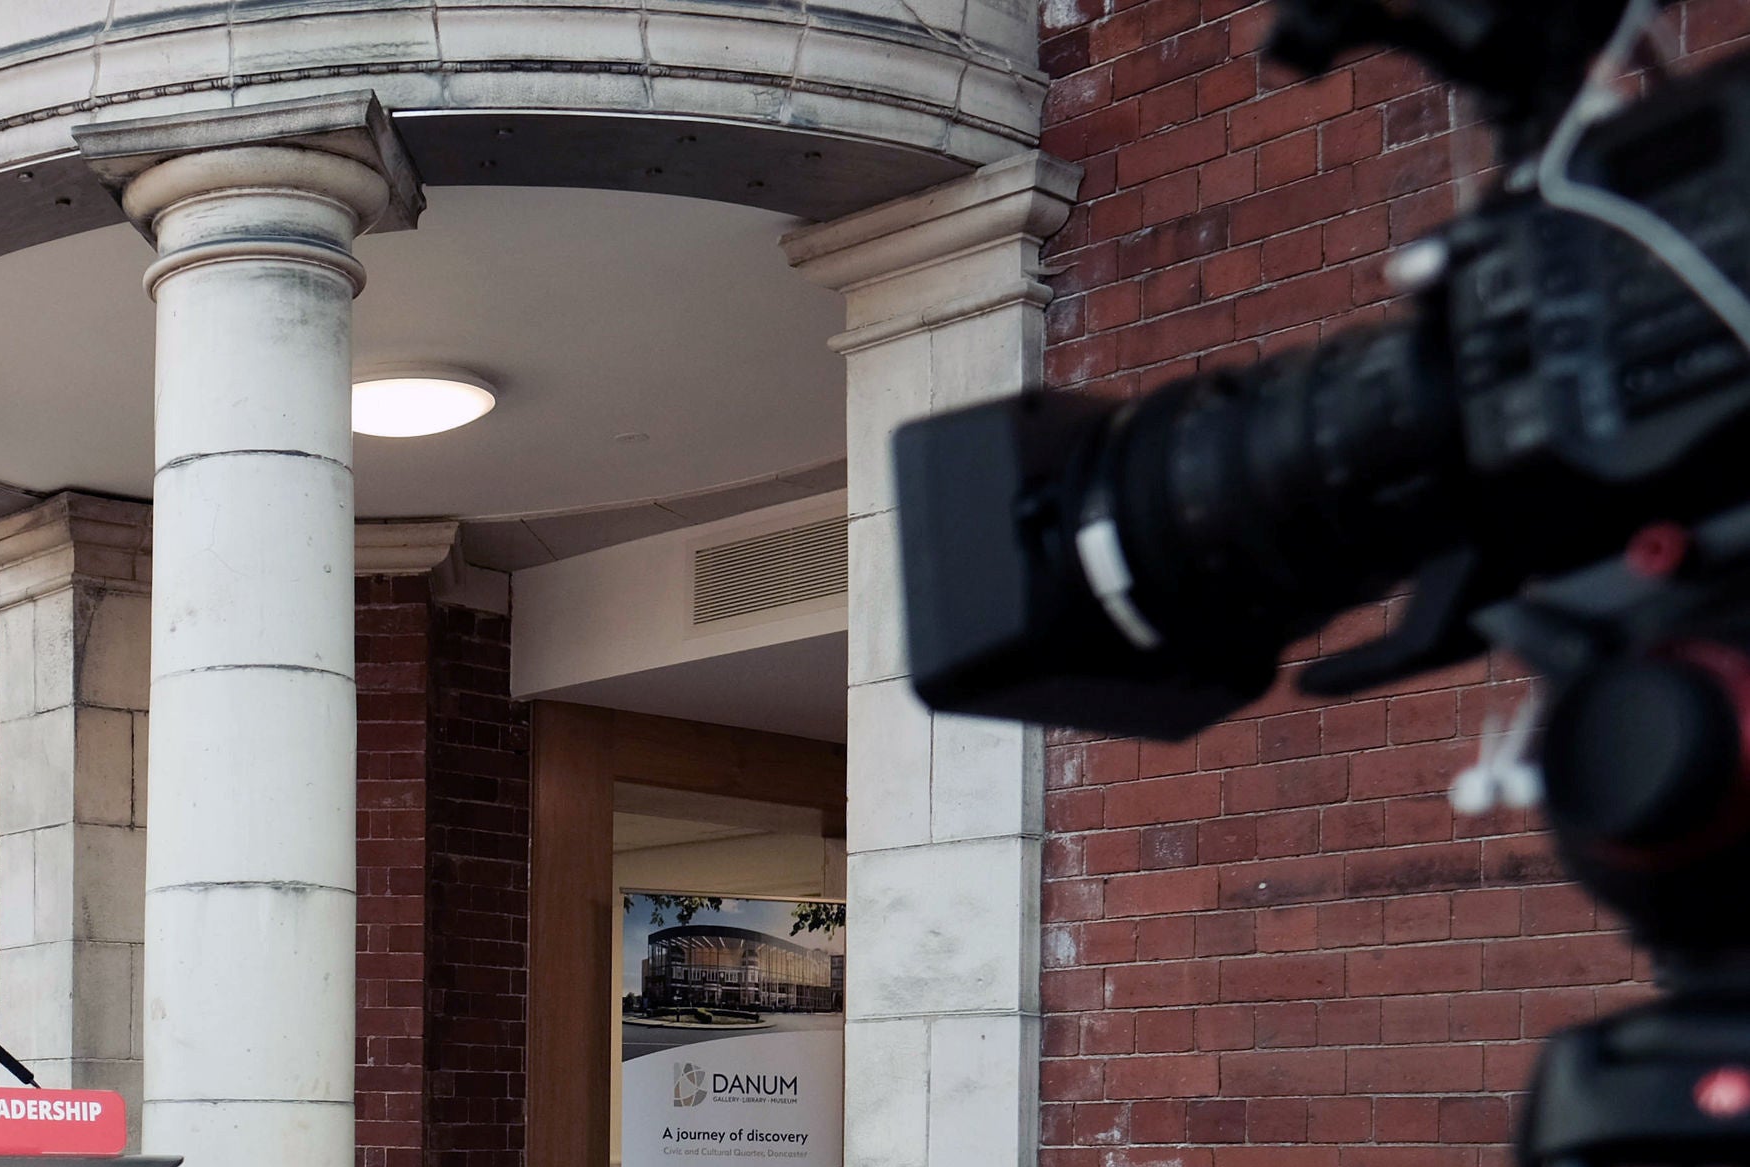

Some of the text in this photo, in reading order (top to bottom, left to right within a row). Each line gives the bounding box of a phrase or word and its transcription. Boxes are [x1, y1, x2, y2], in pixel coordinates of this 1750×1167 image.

[713, 1073, 798, 1095] DANUM
[662, 1127, 809, 1145] A journey of discovery
[663, 1146, 682, 1155] Civic
[684, 1147, 699, 1156] and
[701, 1147, 732, 1156] Cultural
[767, 1149, 808, 1158] Doncaster
